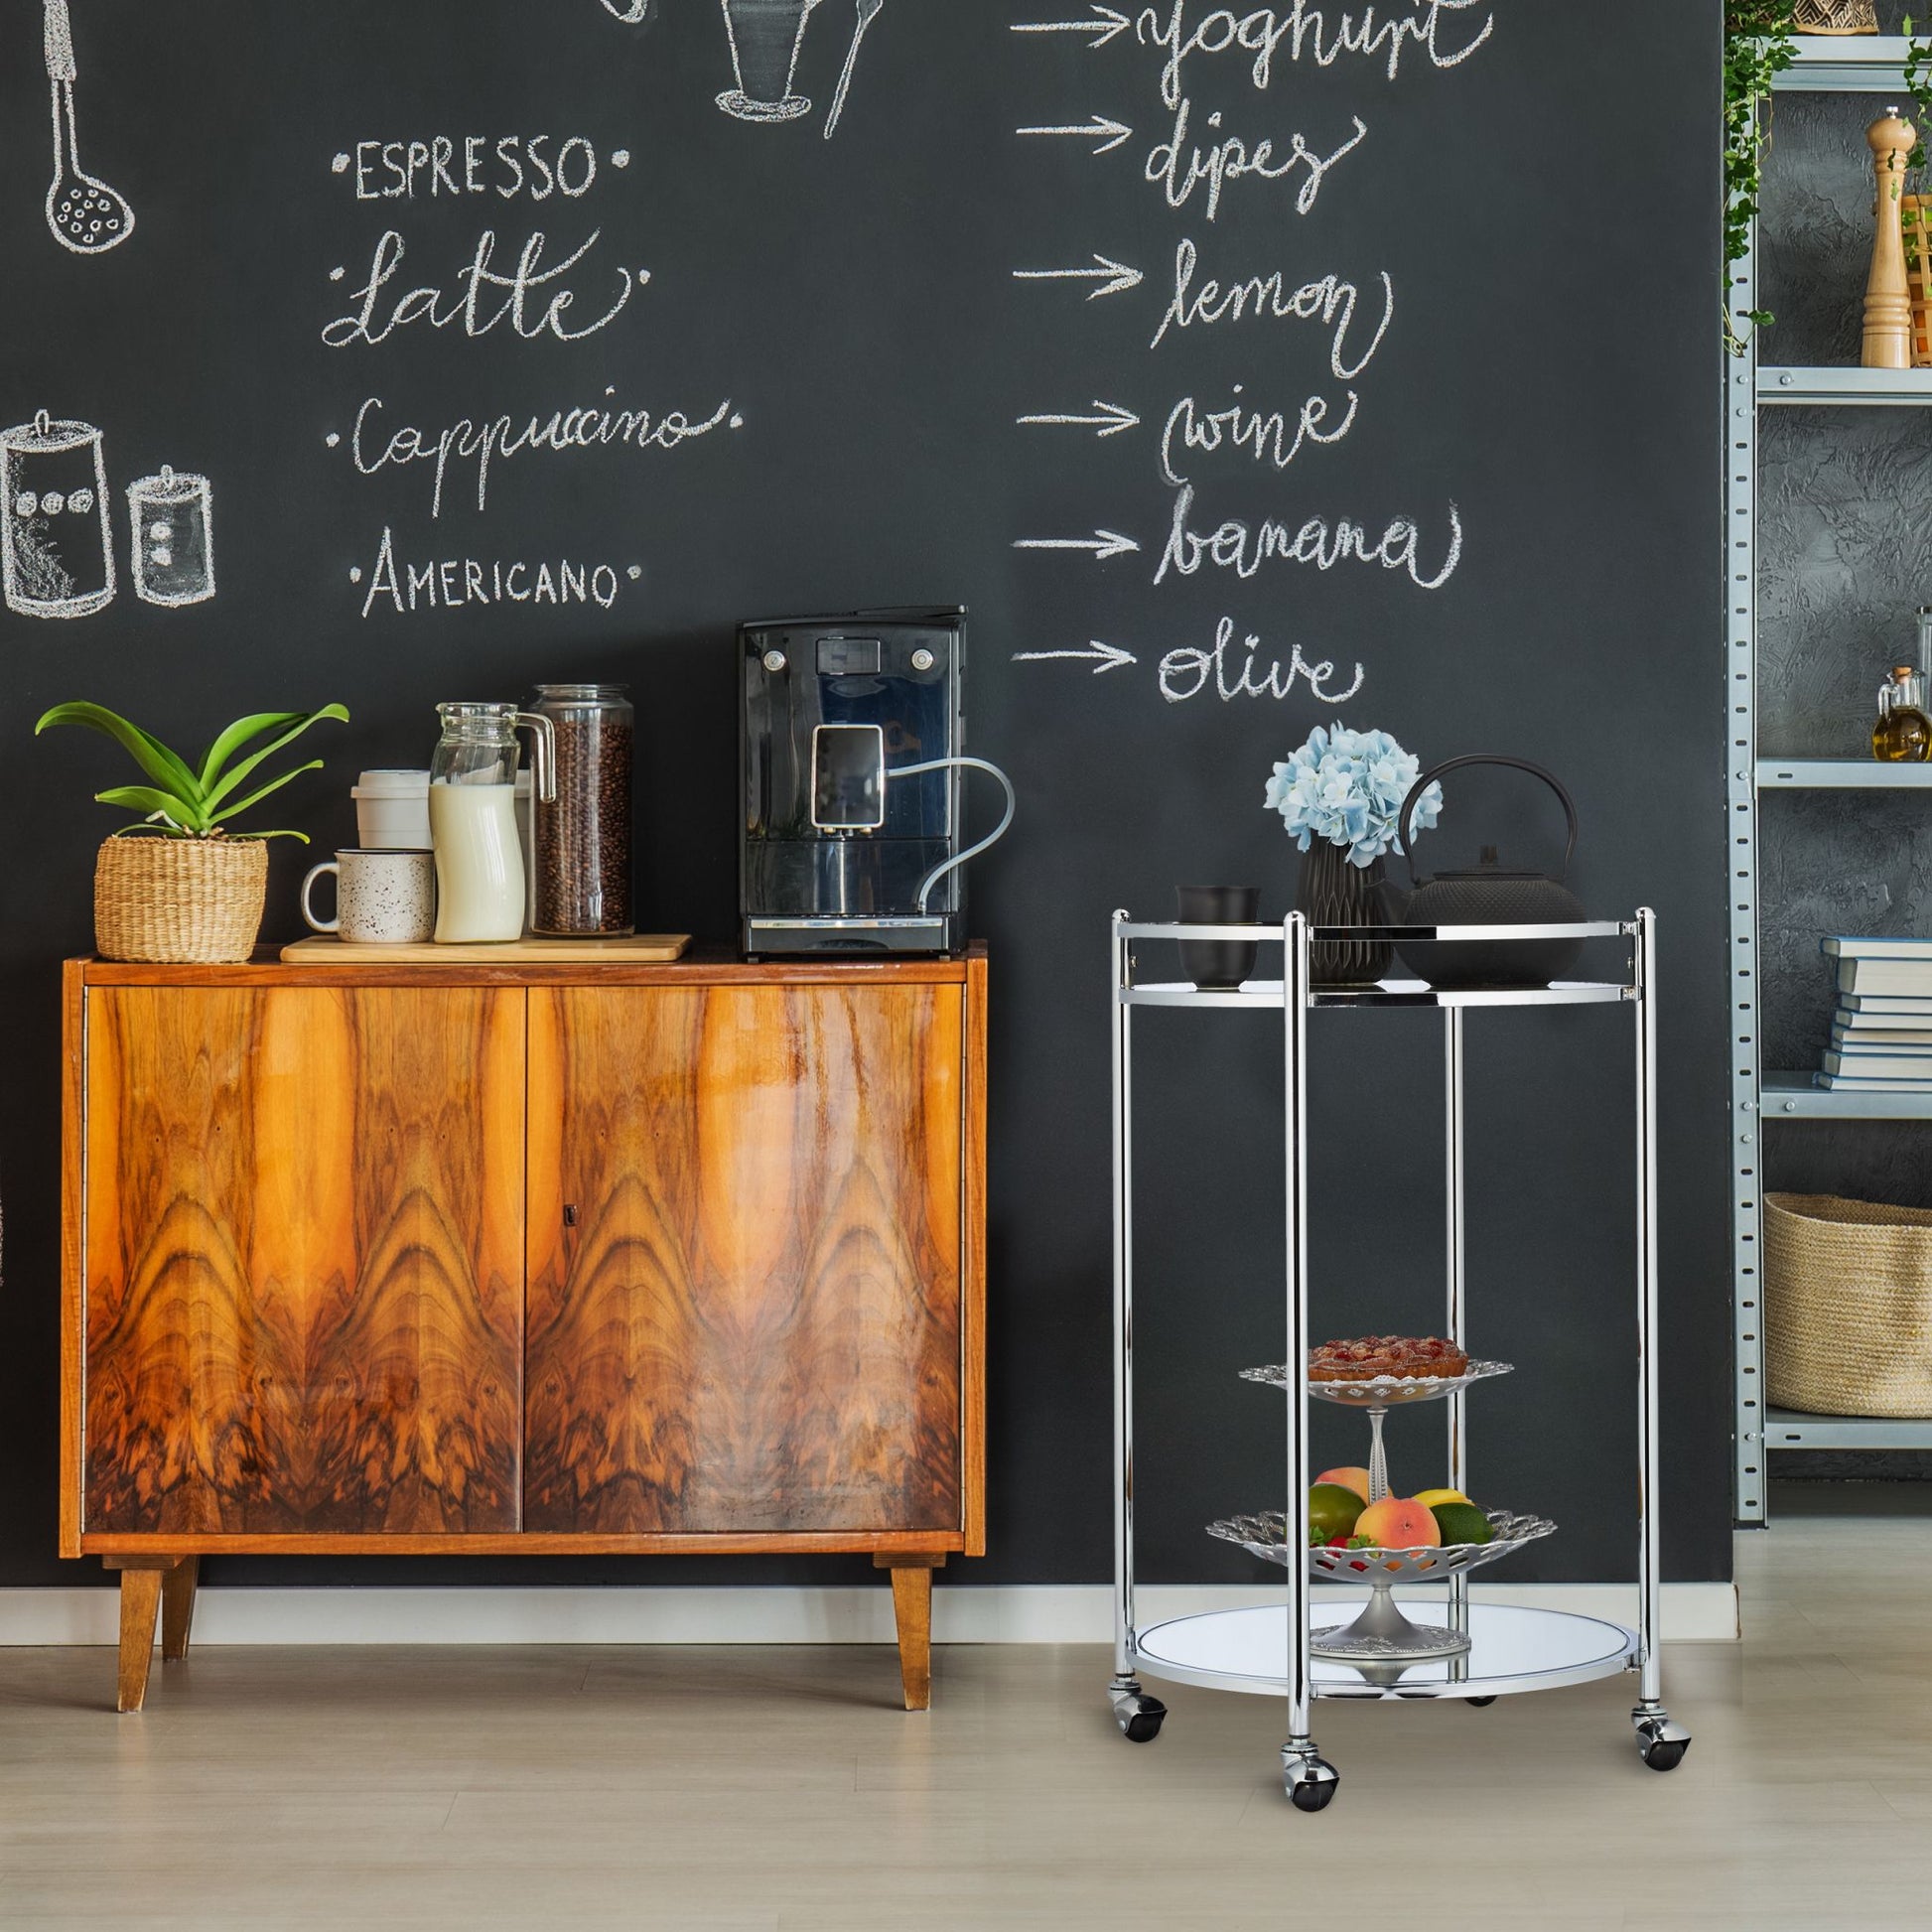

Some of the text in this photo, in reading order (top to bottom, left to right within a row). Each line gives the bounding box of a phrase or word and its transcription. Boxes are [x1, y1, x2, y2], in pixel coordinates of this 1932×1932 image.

[356, 135, 597, 201] ESPRESSO
[321, 229, 632, 347] Latte
[1150, 238, 1393, 379] lemon
[1160, 384, 1359, 485] wine
[1153, 483, 1462, 590] banana
[1158, 616, 1365, 704] olive
